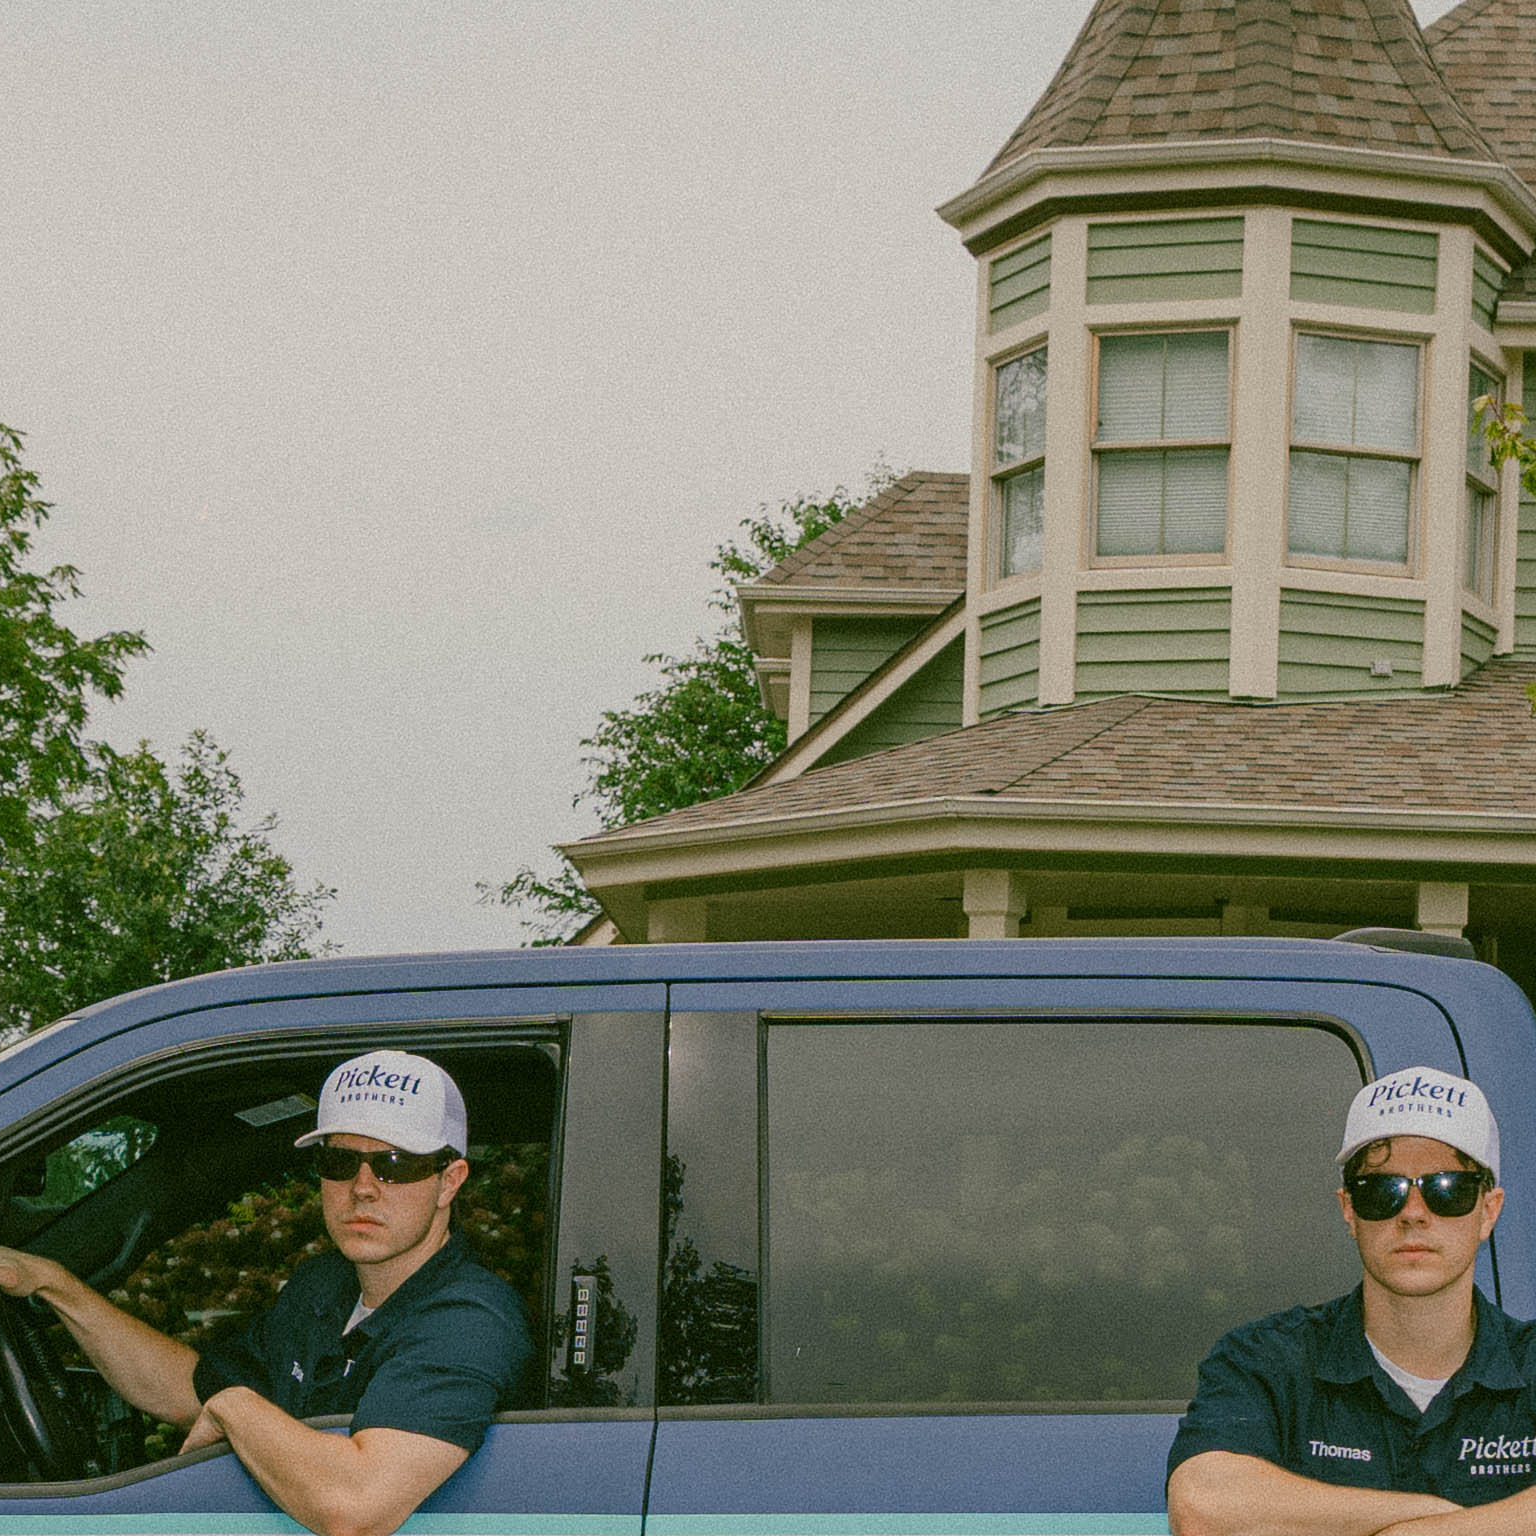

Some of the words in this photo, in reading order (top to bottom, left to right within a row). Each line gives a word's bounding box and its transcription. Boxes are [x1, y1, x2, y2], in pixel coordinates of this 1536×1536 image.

[335, 1065, 421, 1094] Pickett
[341, 1093, 404, 1106] BROTHERS
[1369, 1076, 1468, 1107] Pickett
[1380, 1104, 1452, 1117] BROTHERS
[1309, 1441, 1371, 1461] Thomas
[1470, 1464, 1531, 1475] BROTHERS
